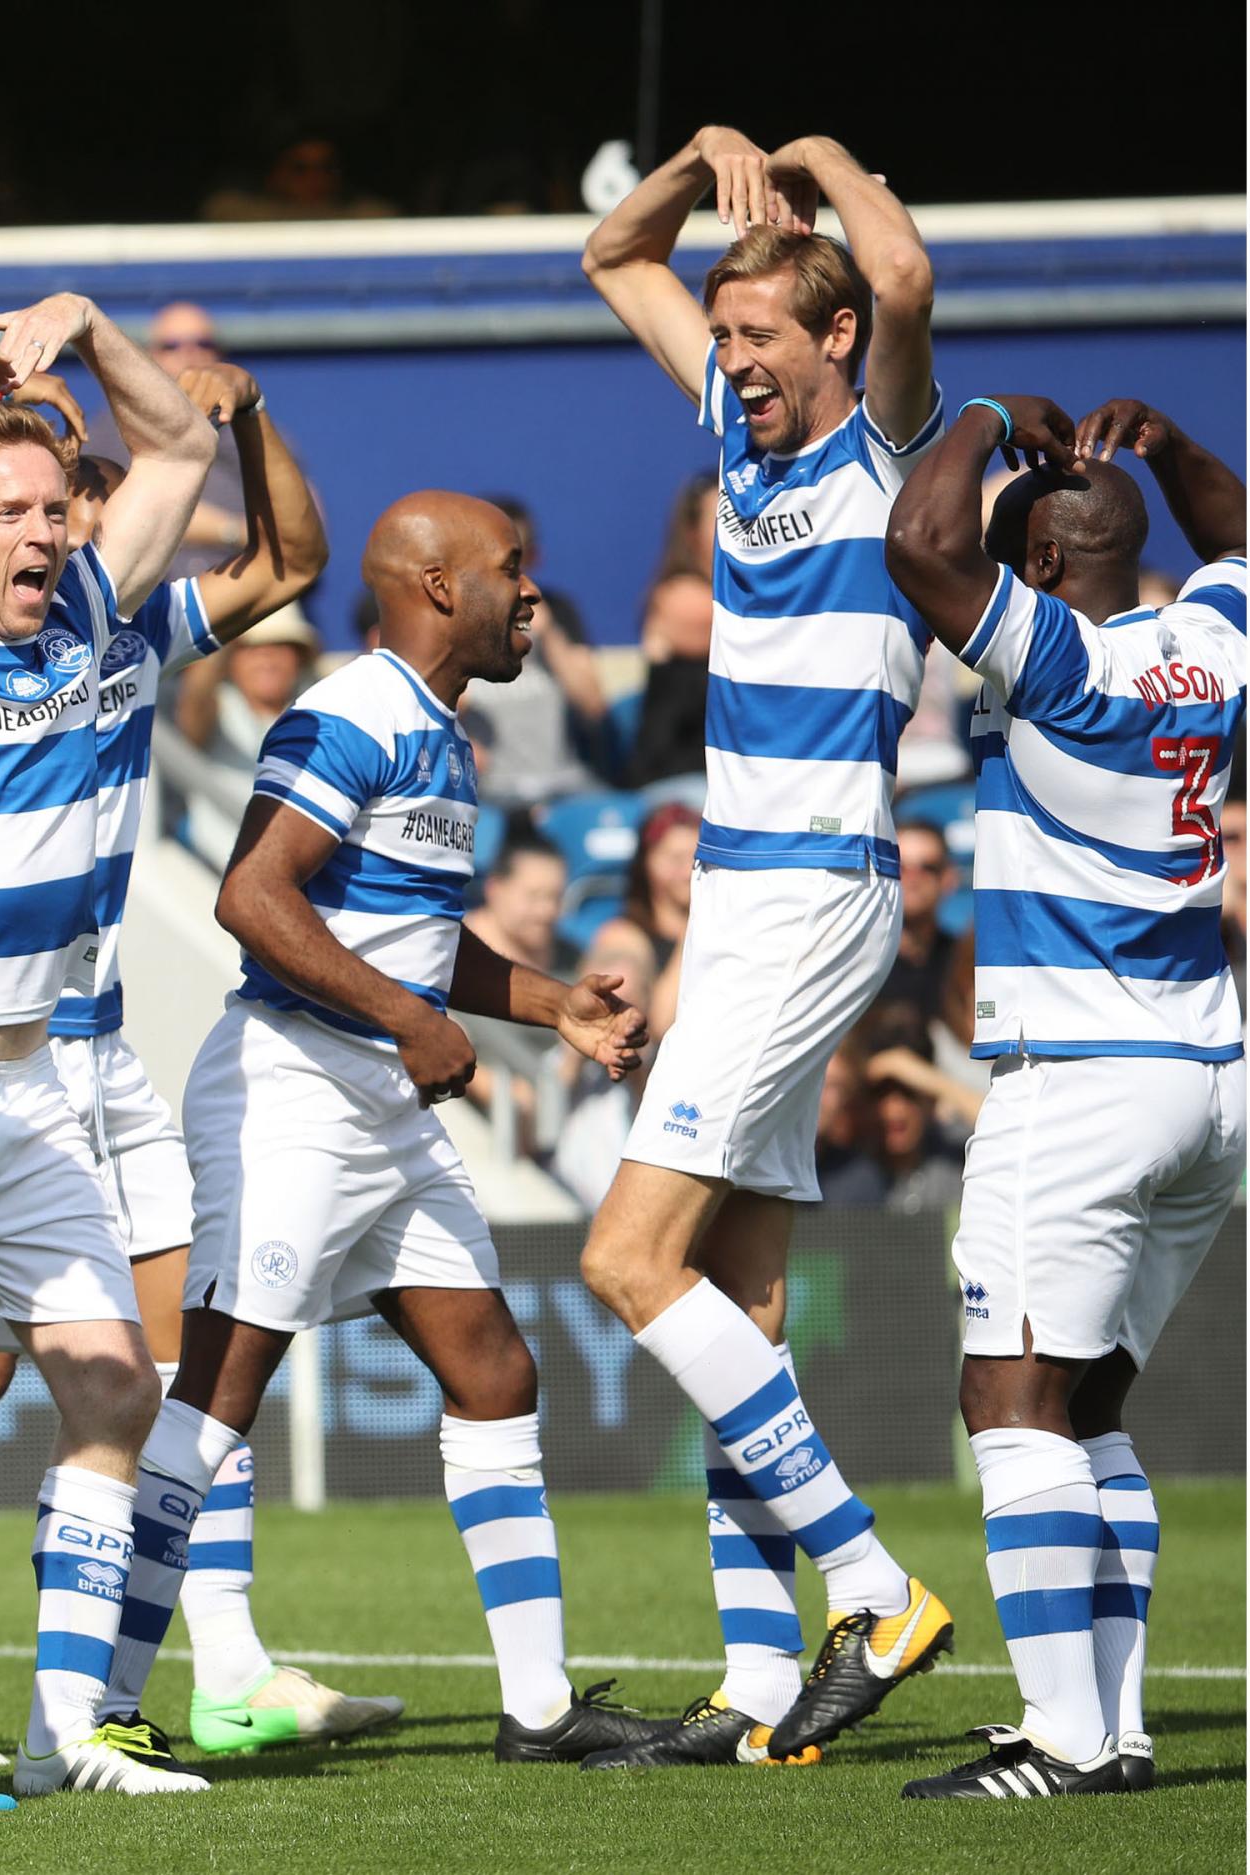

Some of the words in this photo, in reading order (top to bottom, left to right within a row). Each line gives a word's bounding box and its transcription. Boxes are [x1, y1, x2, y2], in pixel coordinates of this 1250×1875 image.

[581, 139, 640, 215] 6
[1152, 736, 1222, 888] 3
[663, 1120, 698, 1139] errea
[742, 1409, 809, 1463] QPR
[781, 1457, 823, 1491] errea
[78, 1578, 124, 1601] errea
